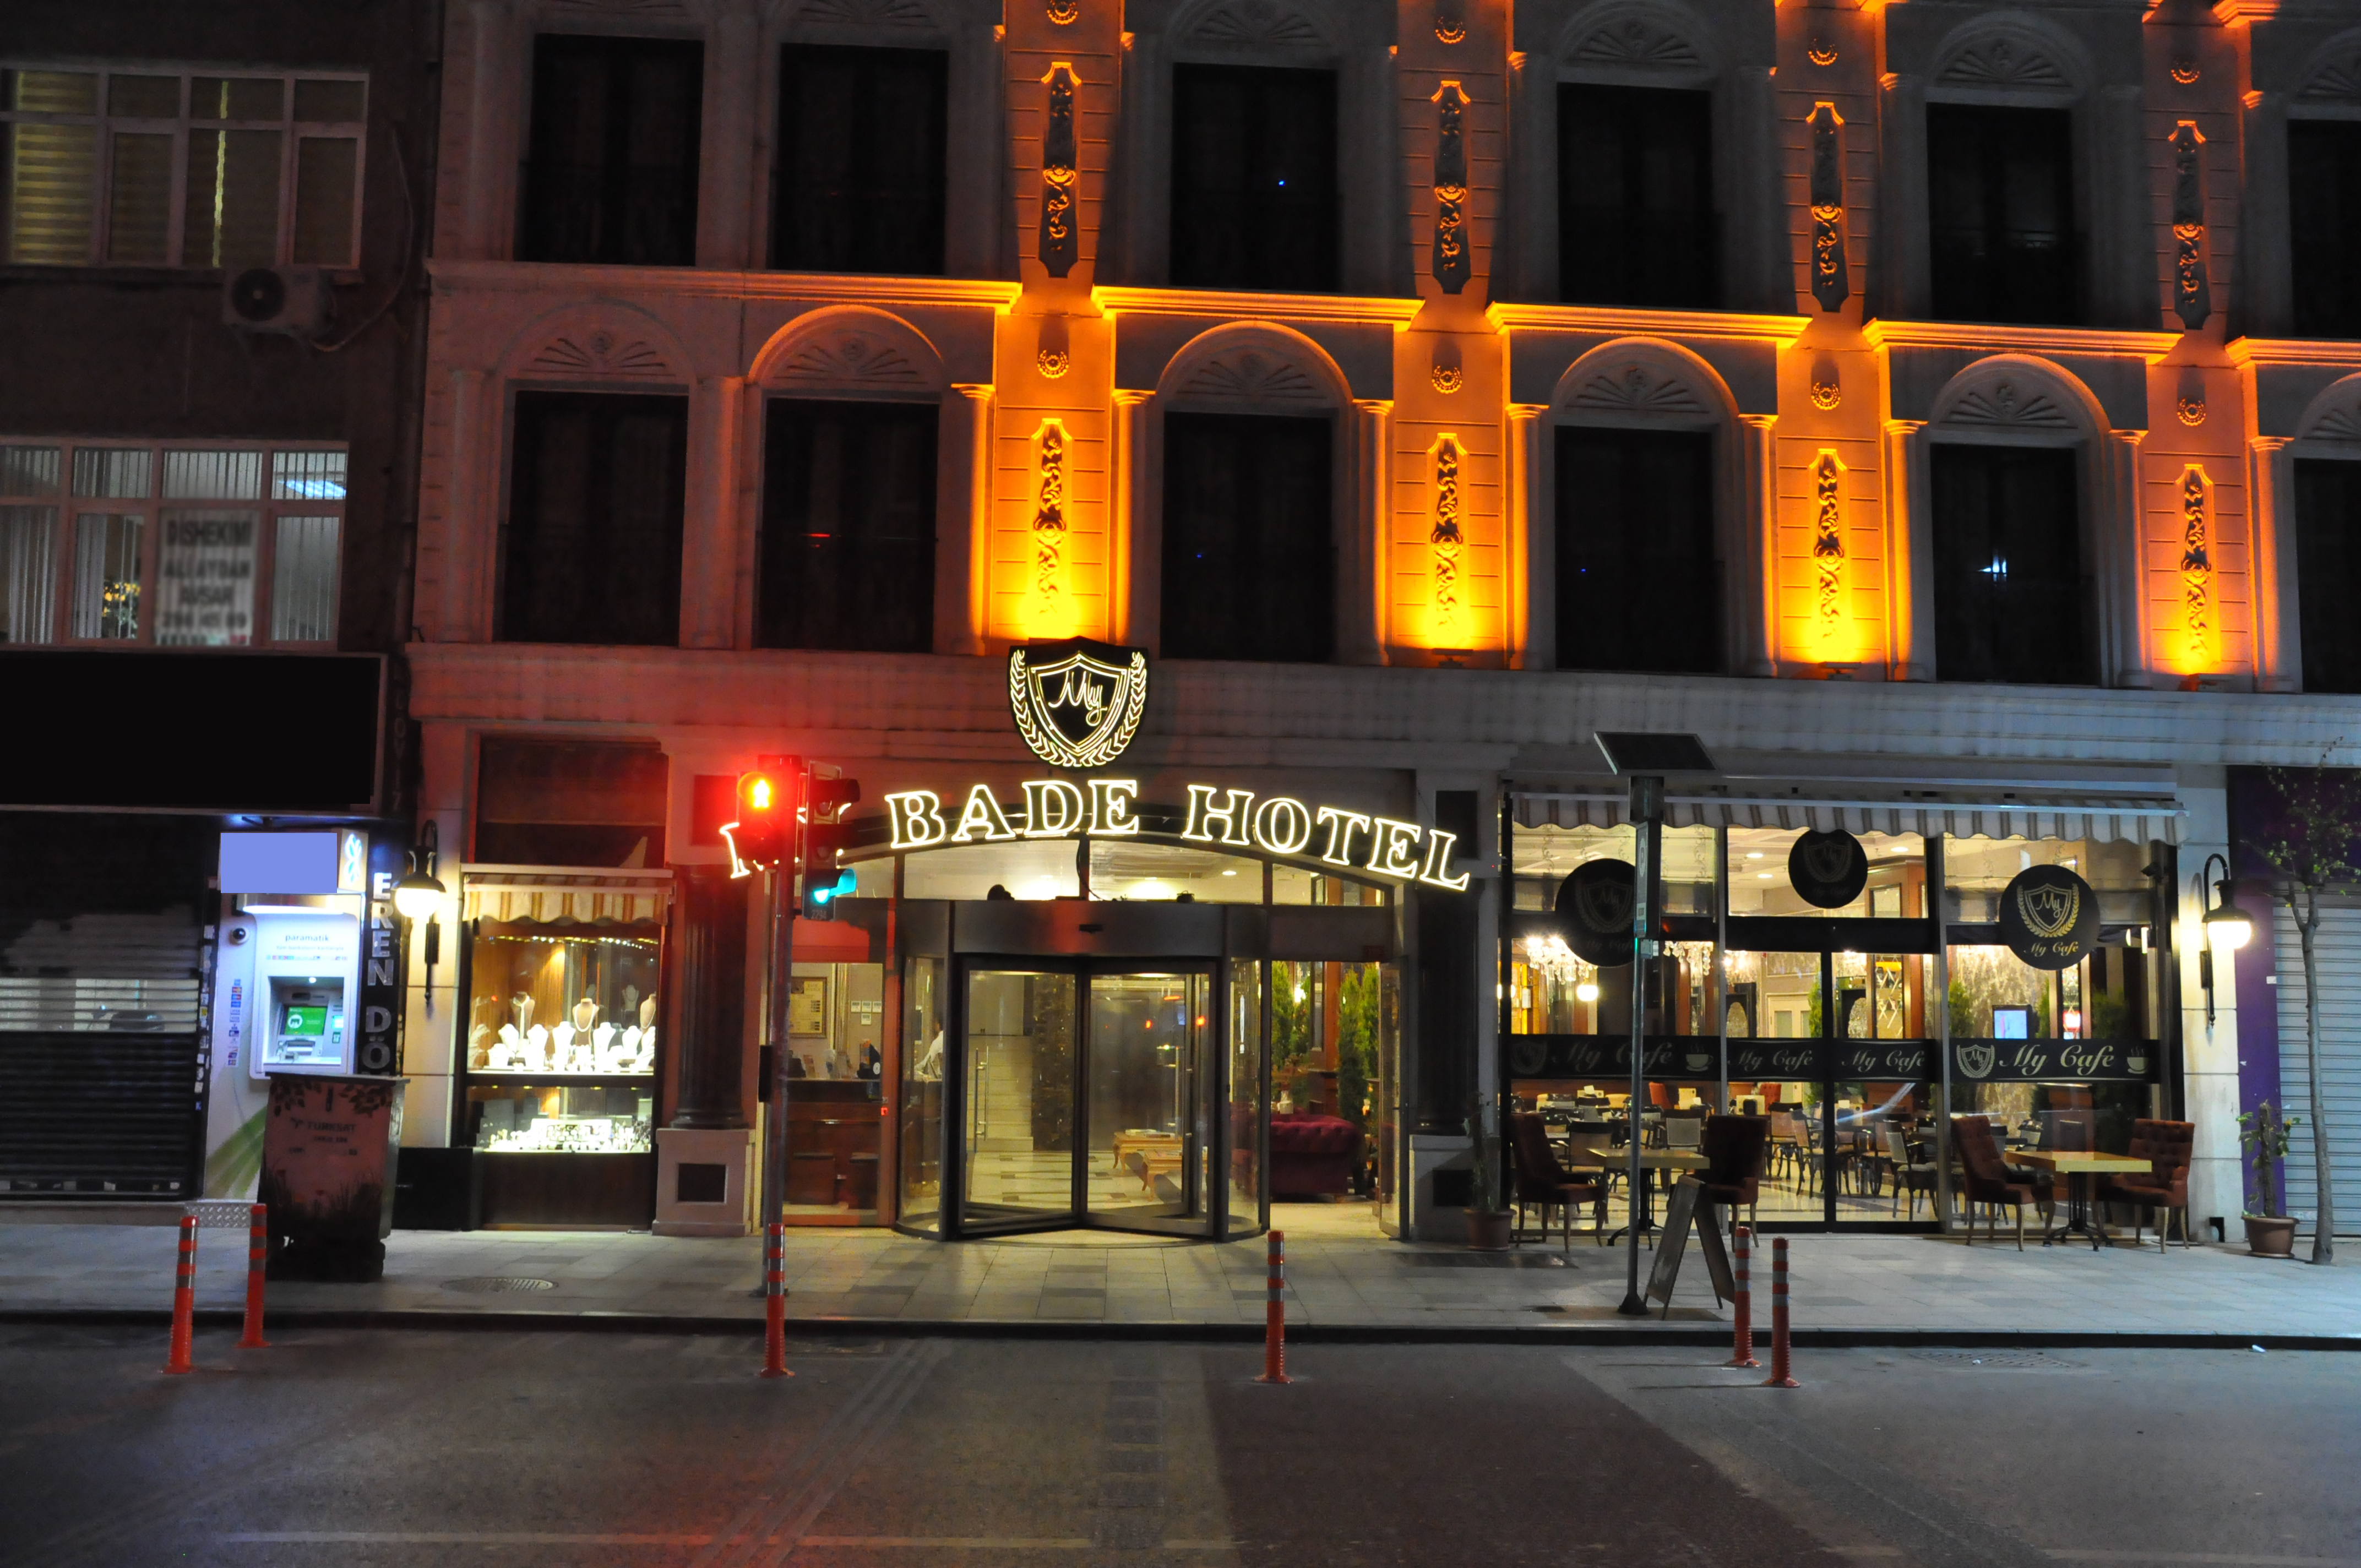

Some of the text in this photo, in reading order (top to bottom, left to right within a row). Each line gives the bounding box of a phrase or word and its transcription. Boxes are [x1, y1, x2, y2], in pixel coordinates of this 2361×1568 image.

[1048, 671, 1108, 726] My
[884, 780, 1139, 850] BADE
[1181, 784, 1471, 891] HOTEL
[2036, 892, 2063, 918] My
[285, 934, 329, 942] paramatik
[367, 873, 394, 986] EREN
[2023, 941, 2079, 957] My Cafe
[361, 1006, 391, 1075] DÖ
[1551, 1041, 1602, 1072] My
[1727, 1049, 1813, 1072] My Cafe
[1841, 1049, 1925, 1073] My Cafe
[1999, 1044, 2114, 1076] My Cafe
